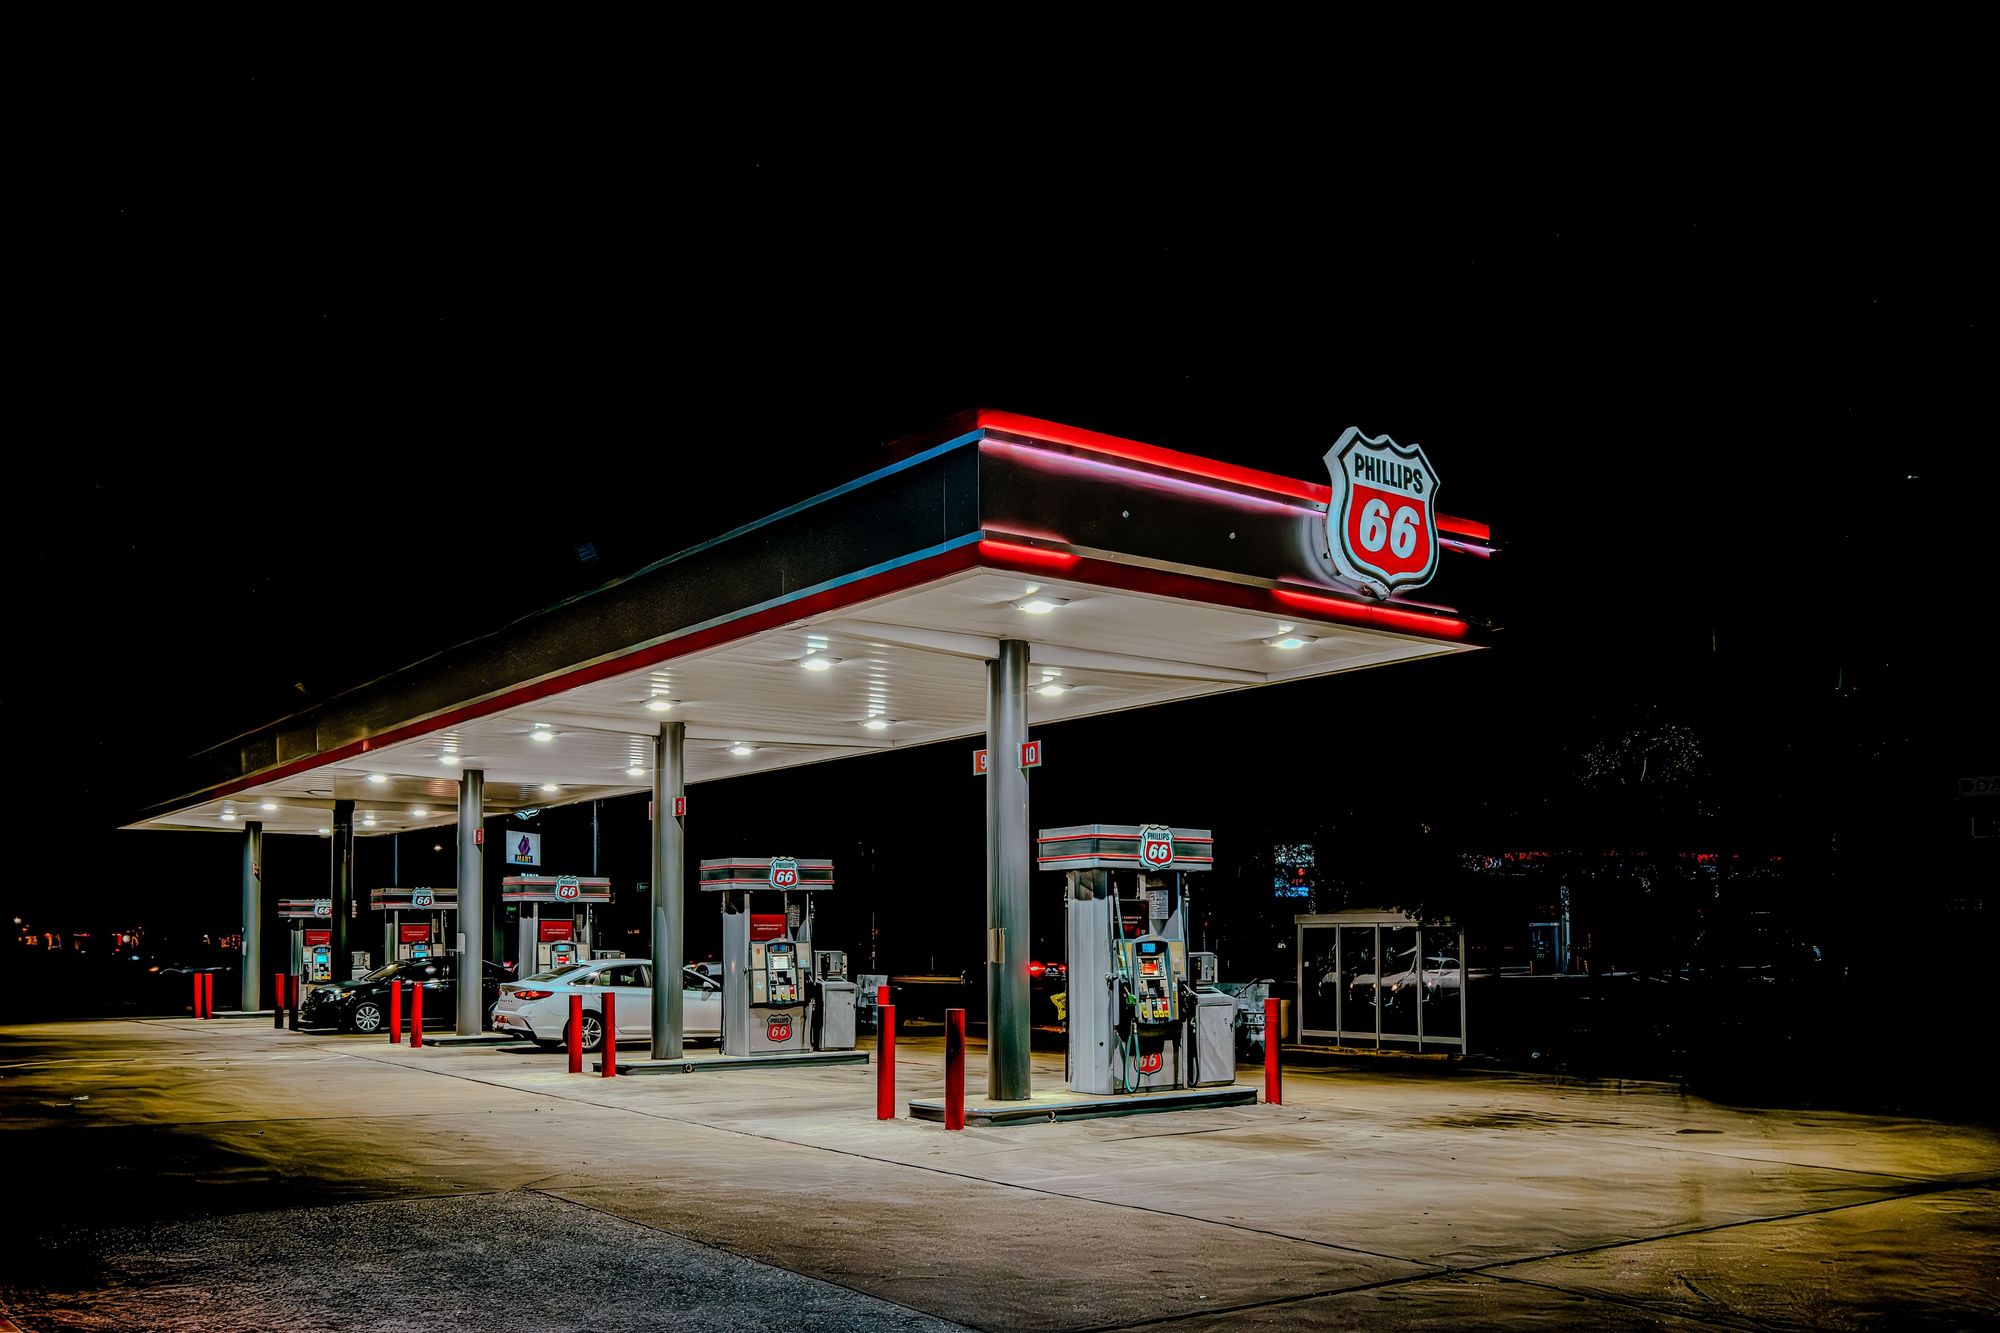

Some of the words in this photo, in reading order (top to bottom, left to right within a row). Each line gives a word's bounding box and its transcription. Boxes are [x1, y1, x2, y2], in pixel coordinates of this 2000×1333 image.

[1354, 453, 1423, 494] PHILLIPS
[1360, 498, 1420, 559] 66
[1025, 746, 1036, 763] 10
[1147, 832, 1170, 841] PHILLIPS
[1148, 844, 1168, 860] 66
[776, 871, 793, 883] 66
[561, 886, 576, 896] 66
[416, 896, 430, 905] 66
[771, 1026, 787, 1037] 66
